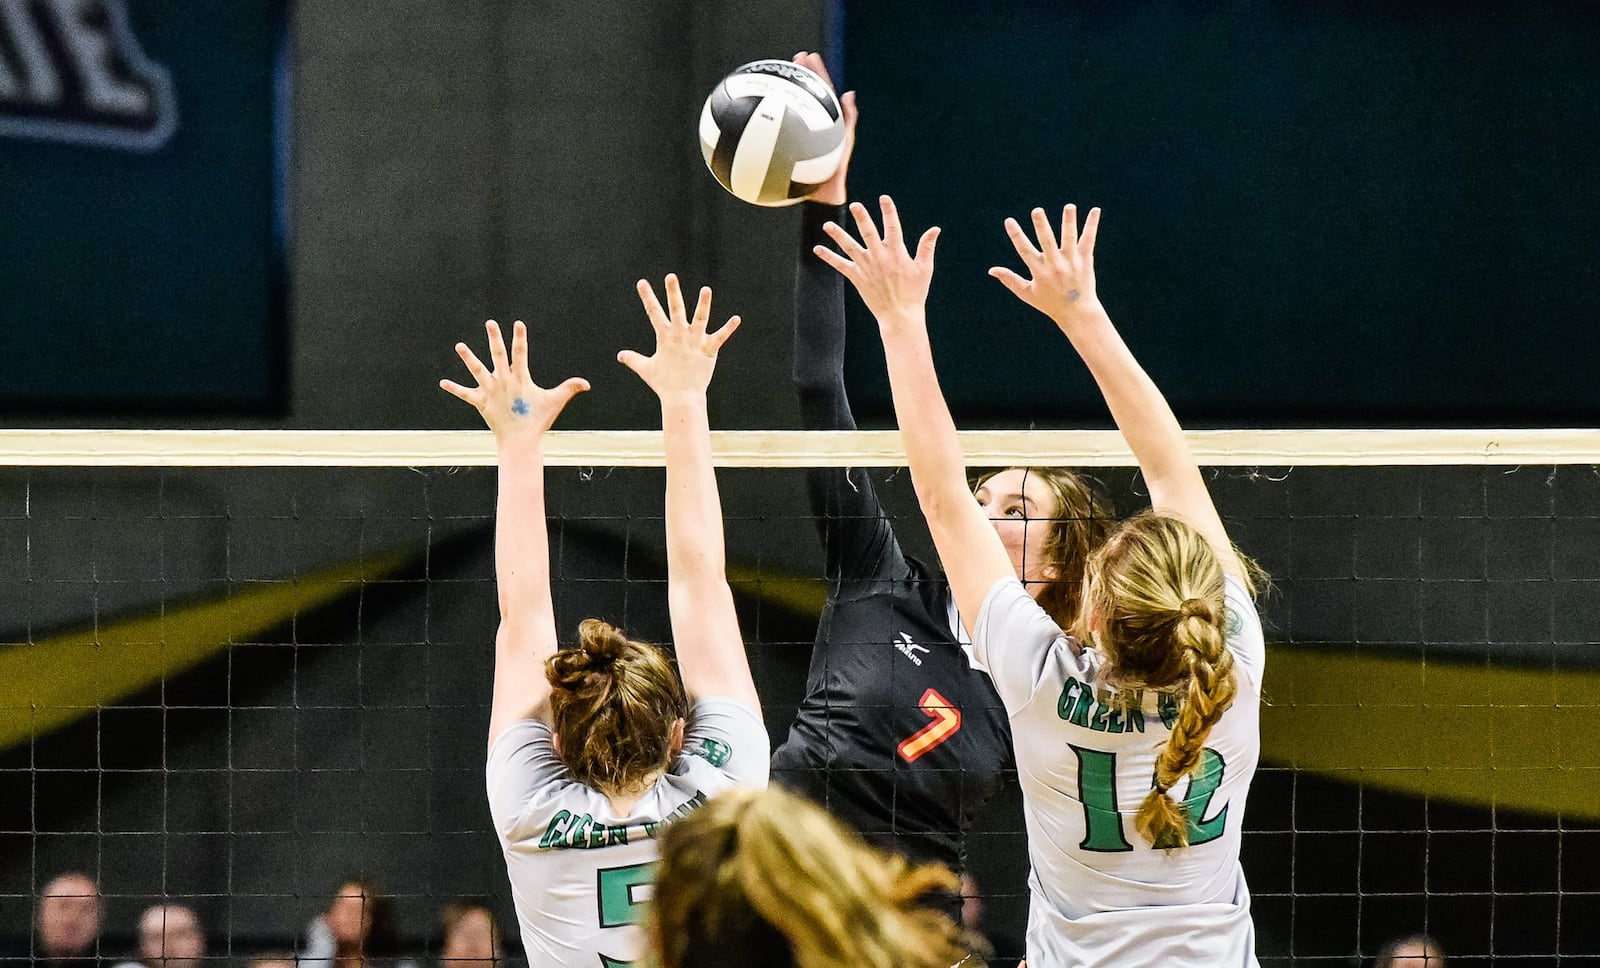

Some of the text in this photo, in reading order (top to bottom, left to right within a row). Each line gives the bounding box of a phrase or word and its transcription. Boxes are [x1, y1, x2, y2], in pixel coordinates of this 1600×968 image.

[896, 687, 963, 764] 7
[1057, 676, 1146, 734] GREEN
[1066, 742, 1230, 852] 12
